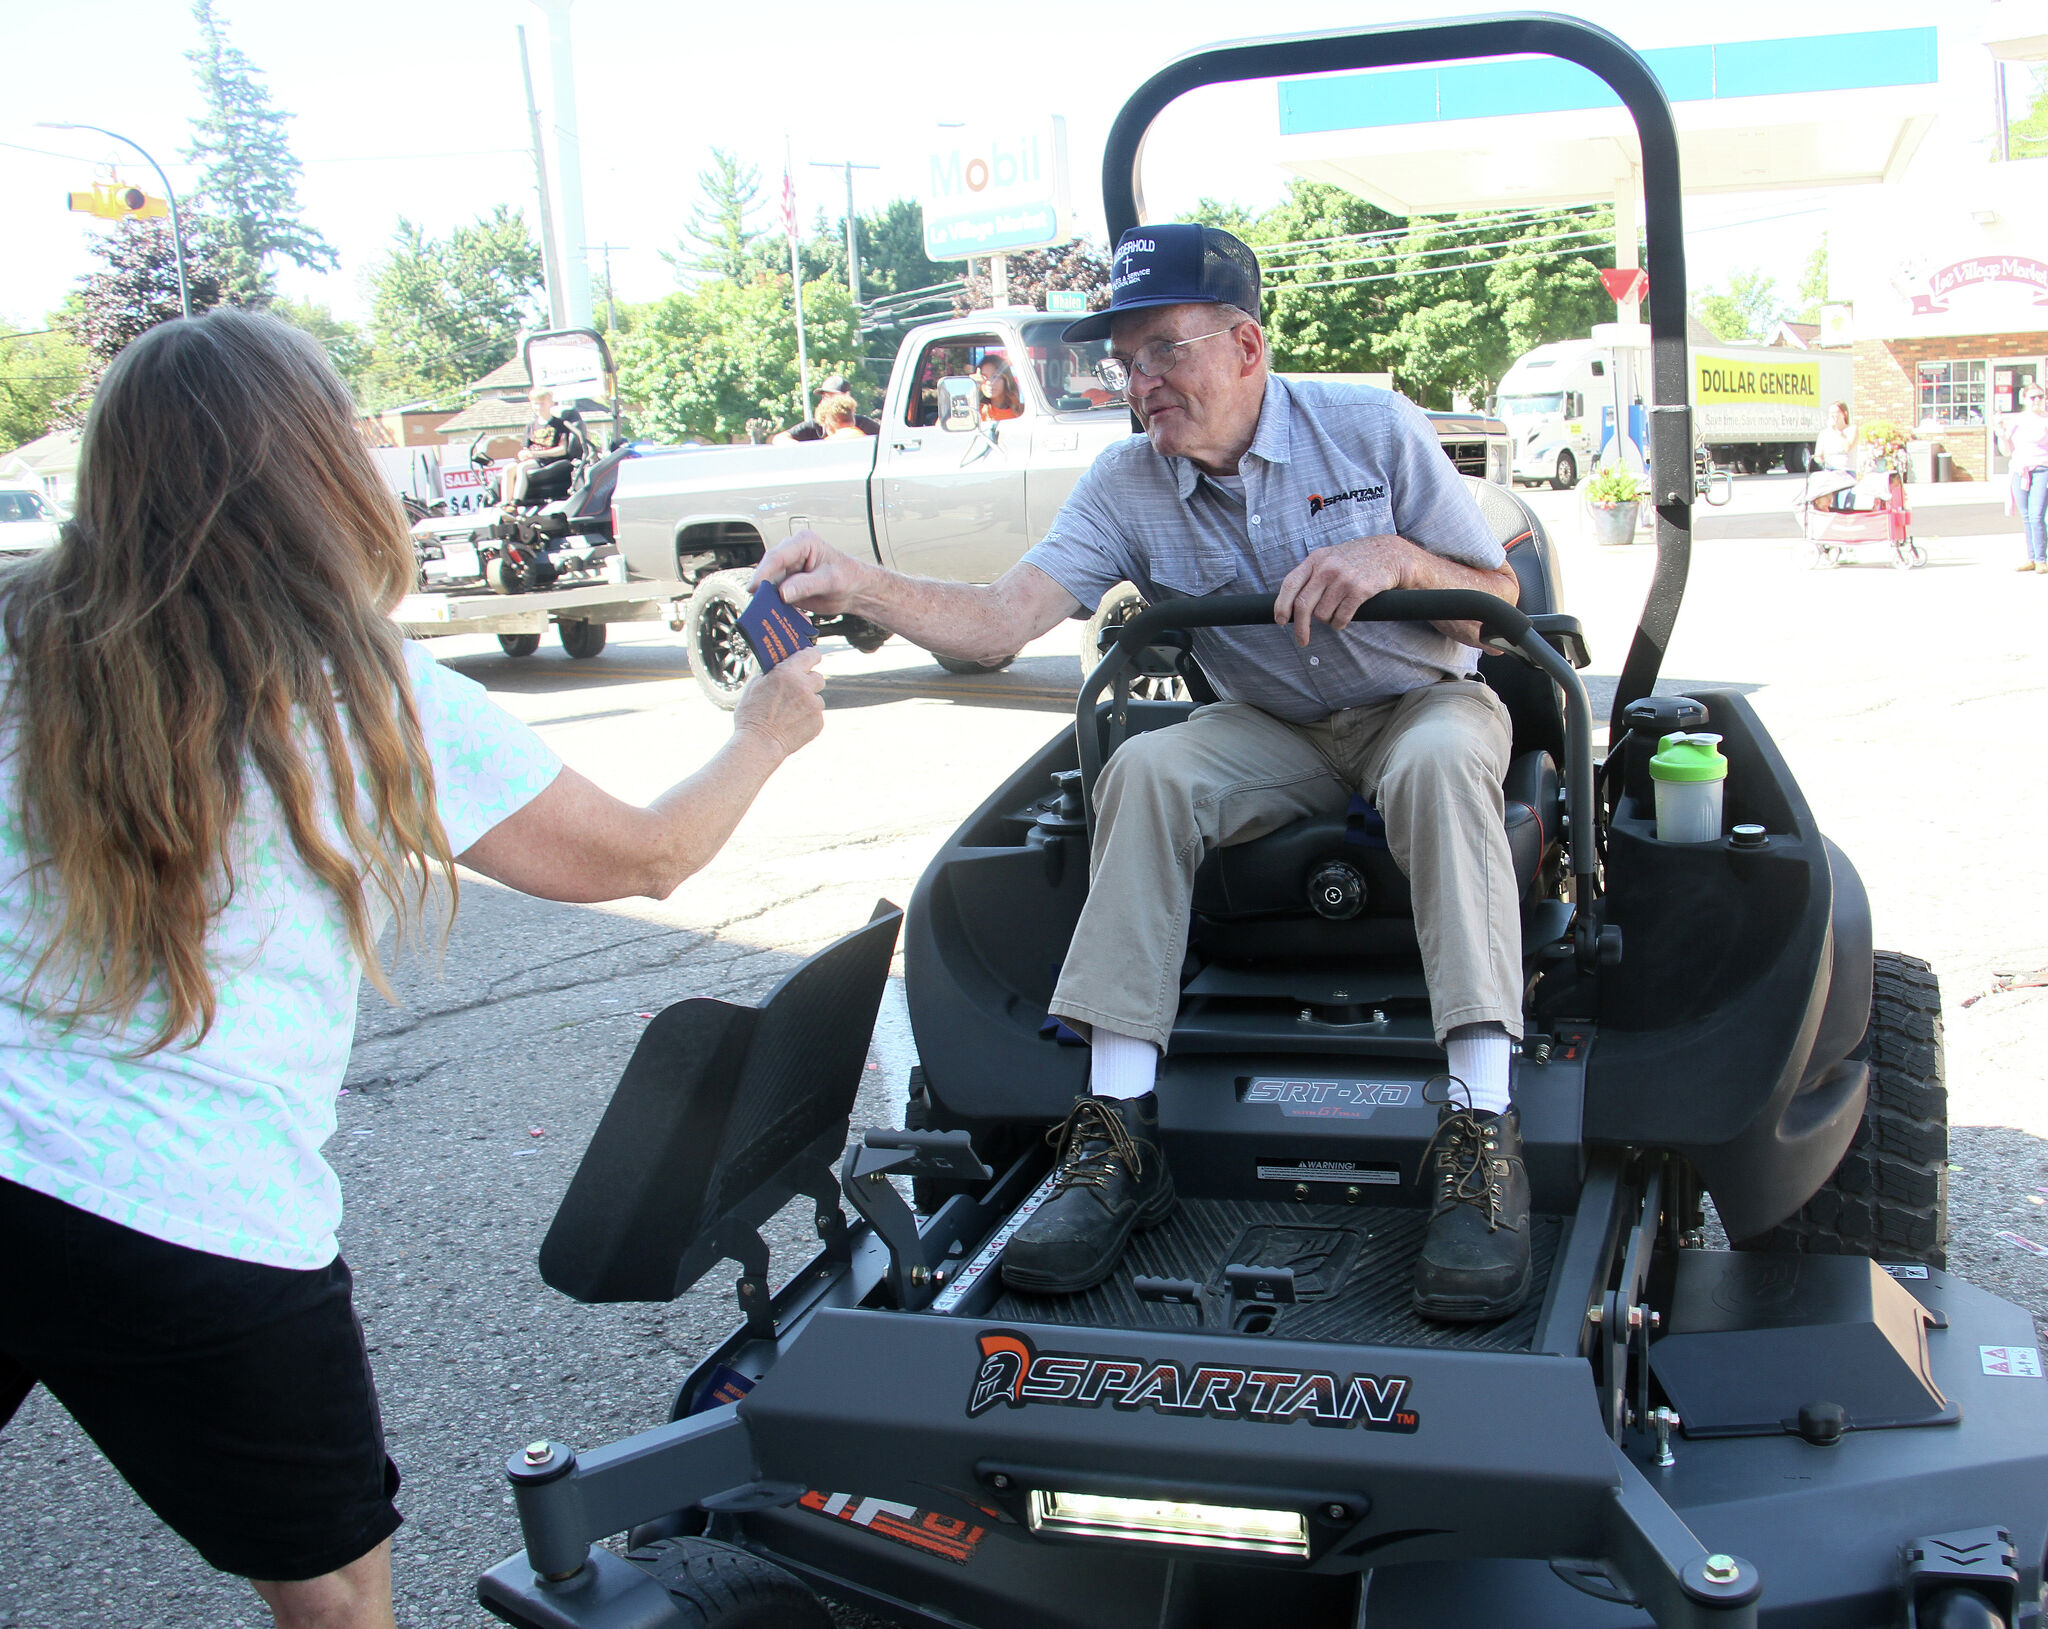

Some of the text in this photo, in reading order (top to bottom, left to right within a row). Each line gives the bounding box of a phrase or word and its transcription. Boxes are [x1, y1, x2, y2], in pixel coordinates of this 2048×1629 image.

[930, 135, 1040, 198] Mobil
[948, 220, 994, 242] Village
[995, 211, 1048, 234] Market
[1127, 268, 1151, 280] SERVICE
[1953, 260, 2000, 284] Village
[1052, 294, 1082, 309] Whalen
[1702, 369, 1815, 396] DOLLAR GENERAL
[1705, 414, 1721, 426] Save
[1781, 414, 1798, 428] Every
[445, 472, 475, 487] SALE
[1323, 485, 1384, 507] SPARTAN
[1357, 493, 1385, 503] MOWERS
[1248, 1080, 1412, 1106] SRT-XD
[1307, 1161, 1356, 1170] WARNING!
[1022, 1356, 1406, 1421] SPARTAN
